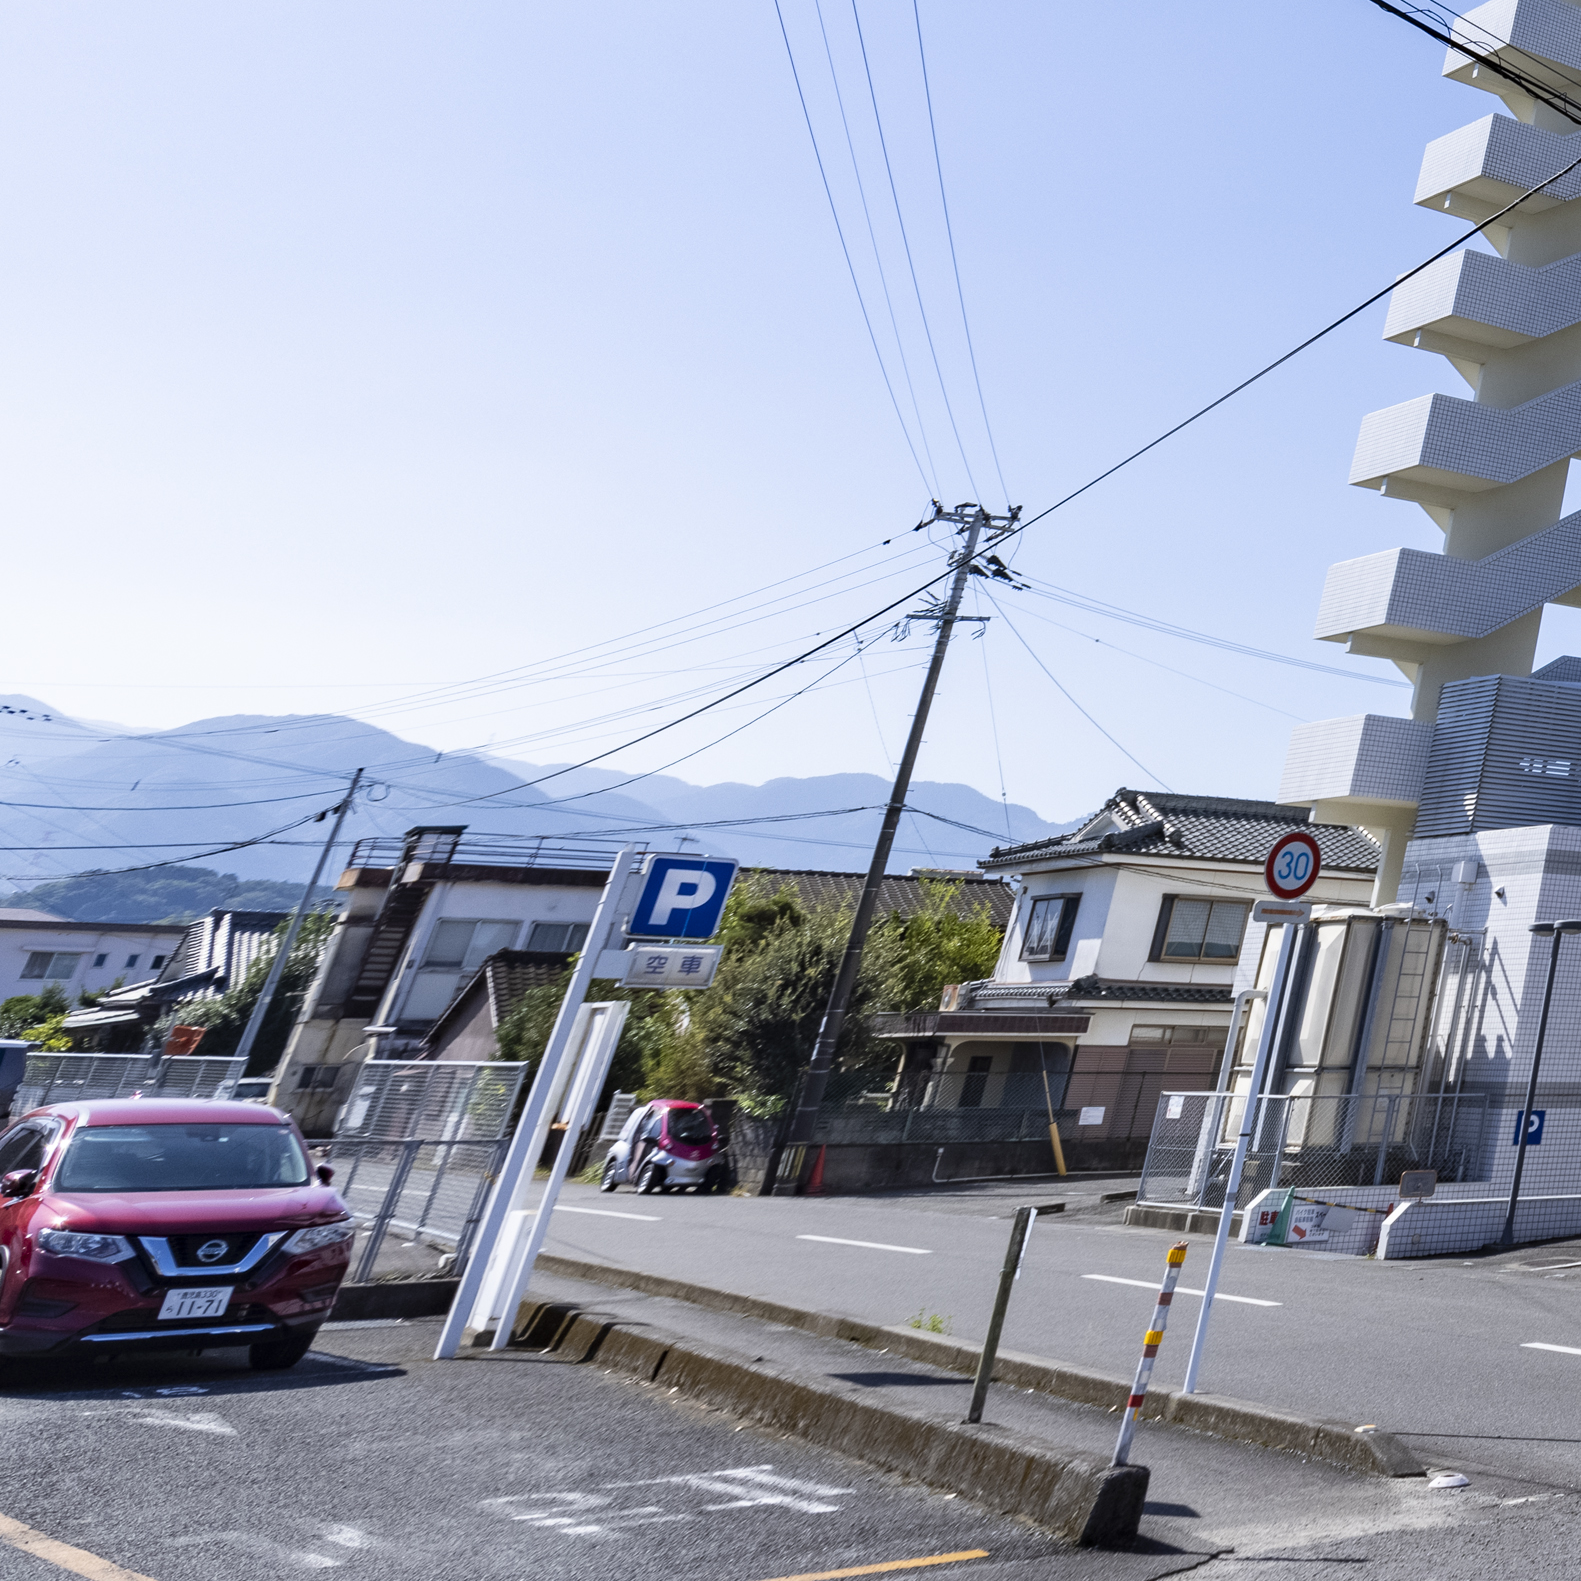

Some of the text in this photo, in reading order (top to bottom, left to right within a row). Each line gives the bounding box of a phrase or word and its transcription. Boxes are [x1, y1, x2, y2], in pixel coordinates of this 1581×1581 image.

[1277, 850, 1310, 881] 30
[647, 868, 717, 926] P
[643, 954, 704, 975] 空車
[176, 1299, 223, 1316] 11-71
